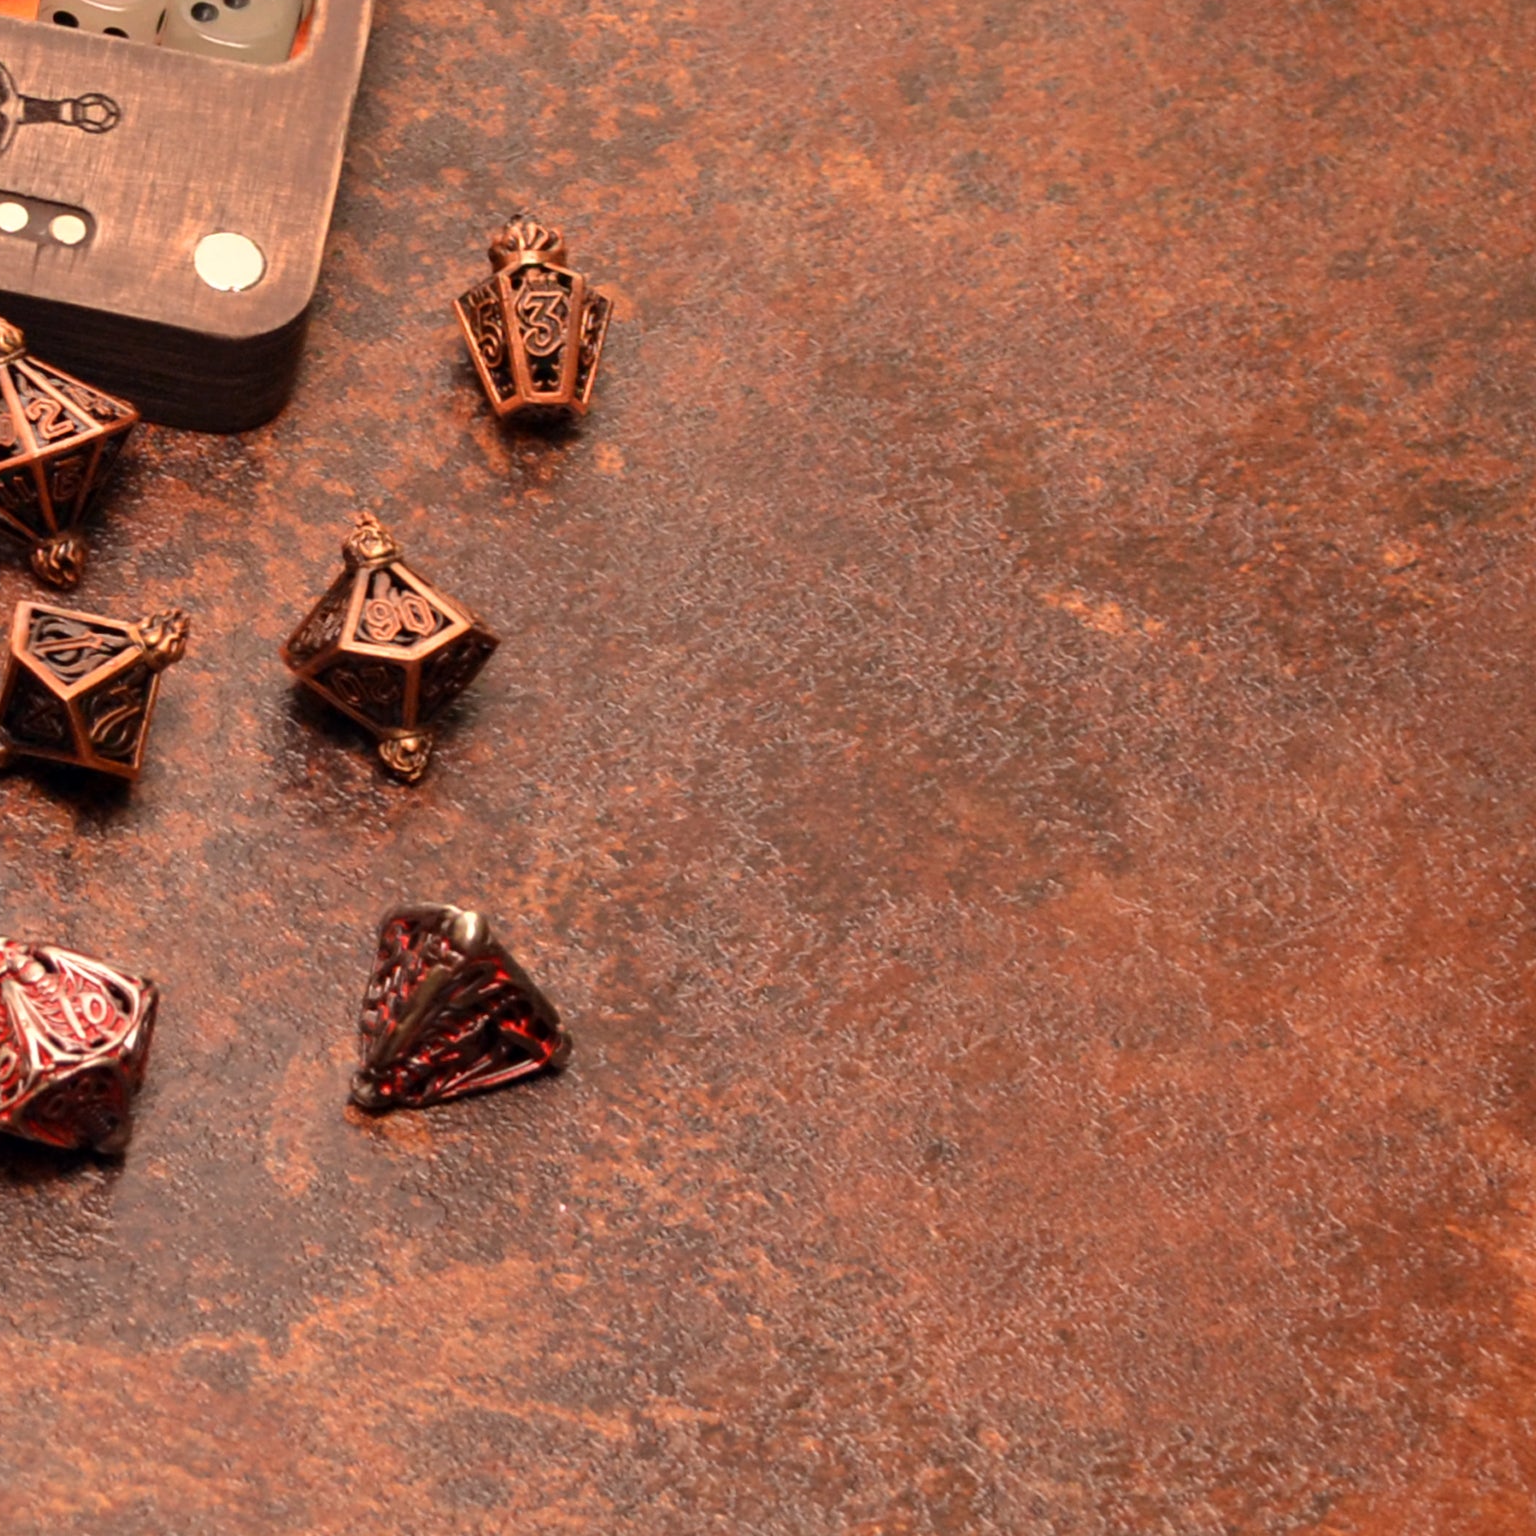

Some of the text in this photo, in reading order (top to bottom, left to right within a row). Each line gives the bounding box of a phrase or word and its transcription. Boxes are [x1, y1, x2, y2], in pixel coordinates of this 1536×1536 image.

[523, 290, 566, 357] 3
[26, 396, 75, 440] 2
[364, 589, 437, 642] 90
